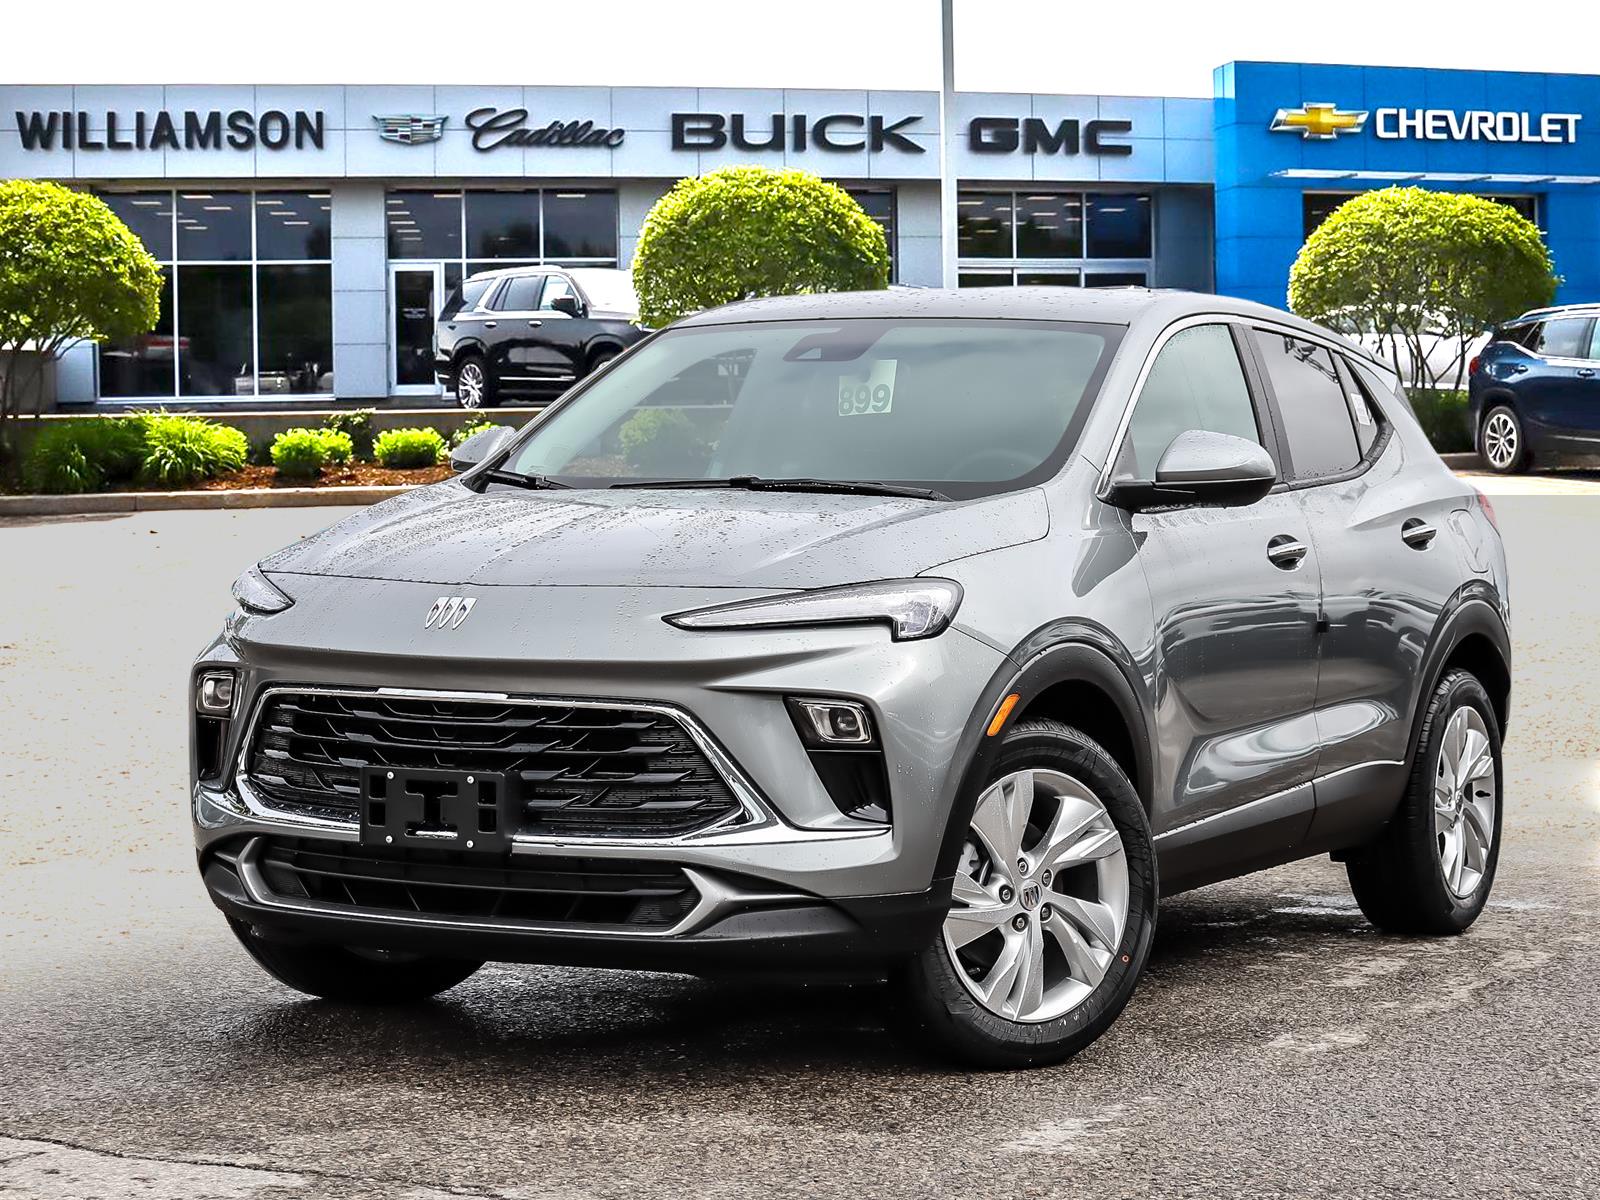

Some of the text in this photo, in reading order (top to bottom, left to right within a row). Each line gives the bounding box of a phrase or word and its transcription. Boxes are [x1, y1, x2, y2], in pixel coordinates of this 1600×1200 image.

[16, 110, 325, 150] WILLIAMSON
[465, 107, 626, 152] Cadillac
[672, 113, 926, 153] BUICK
[970, 117, 1132, 155] GMC
[1376, 108, 1582, 143] CHEVROLET
[839, 384, 891, 415] 899
